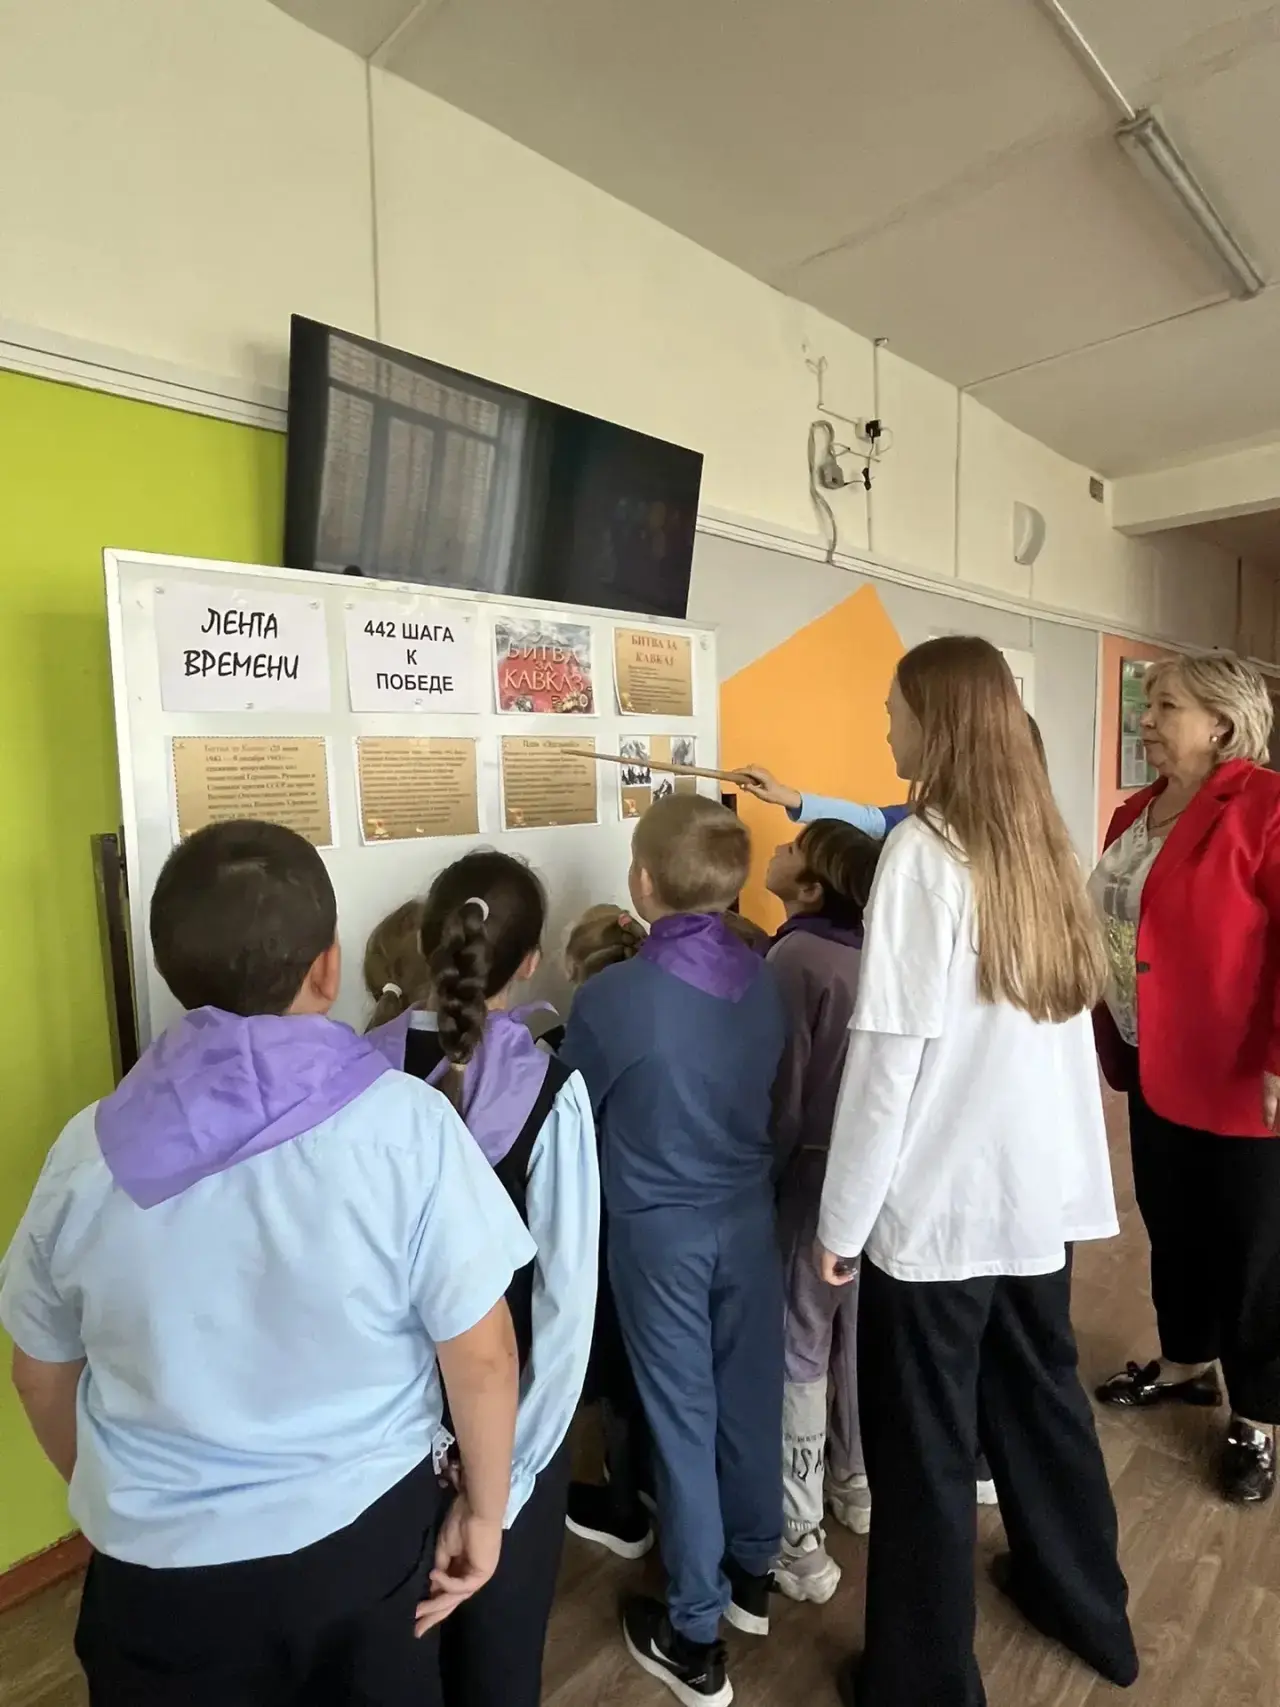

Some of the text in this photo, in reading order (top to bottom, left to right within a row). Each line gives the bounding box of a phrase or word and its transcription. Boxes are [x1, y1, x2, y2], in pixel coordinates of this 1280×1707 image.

[201, 607, 279, 639] ЛЕНТА
[364, 620, 455, 642] 442 ШАГА
[407, 649, 417, 665] К
[507, 640, 580, 664] БИТВА
[183, 649, 300, 681] ВРЕМЕНИ
[376, 673, 454, 694] ПОБЕДЕ
[504, 668, 584, 692] КАВКАЗ
